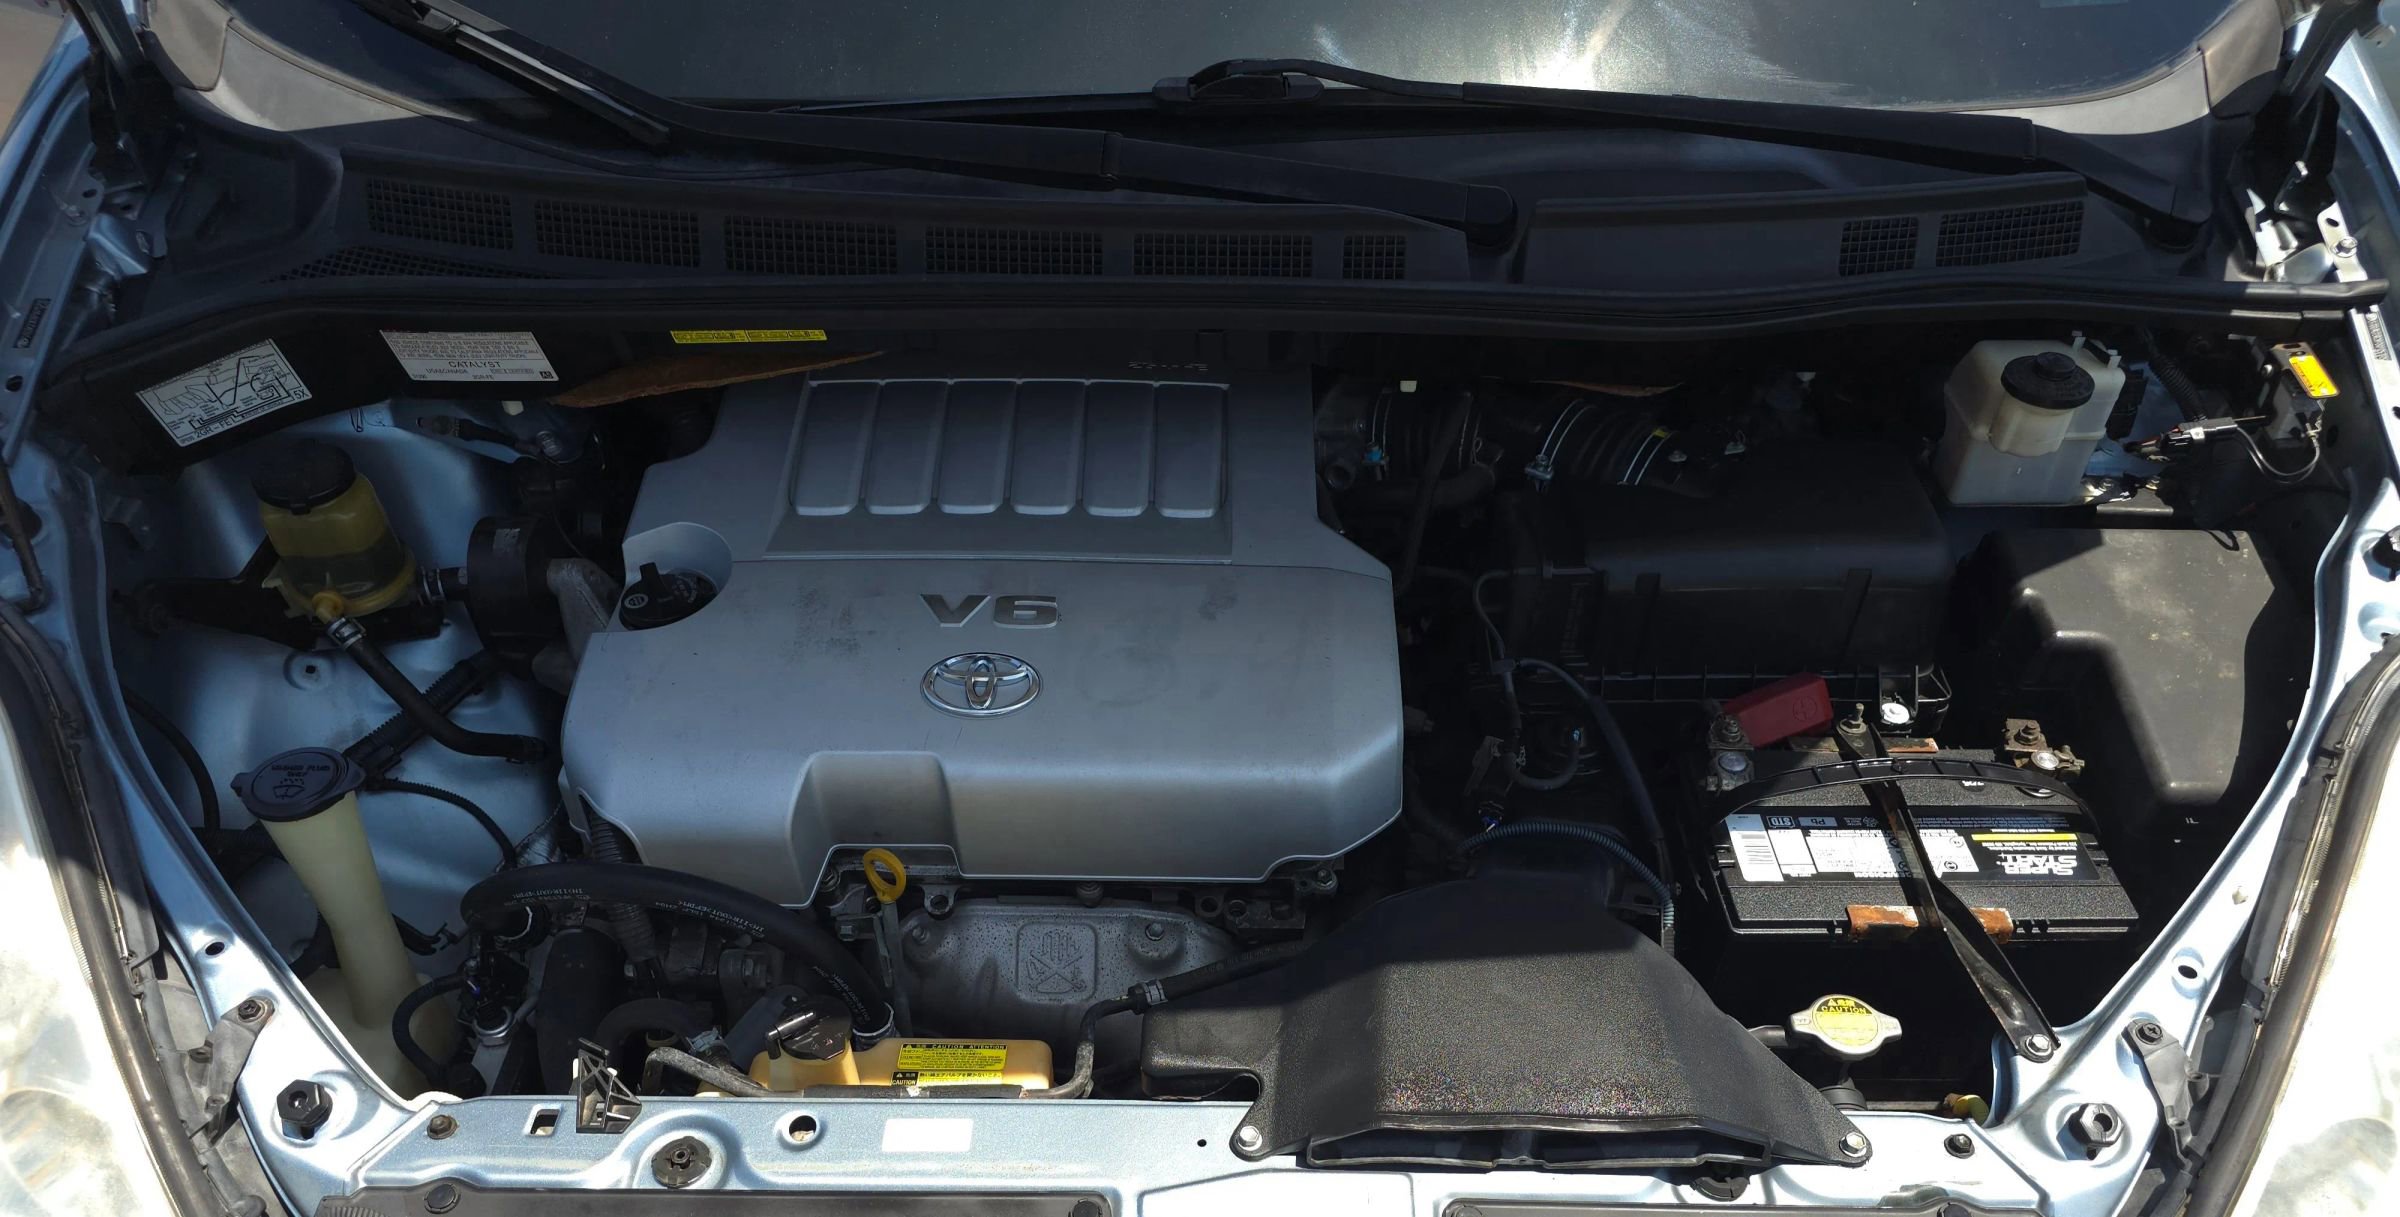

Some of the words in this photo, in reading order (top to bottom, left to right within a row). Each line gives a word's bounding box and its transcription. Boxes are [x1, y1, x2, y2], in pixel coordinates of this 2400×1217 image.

[293, 388, 310, 400] 5X
[920, 594, 1058, 629] V6
[1769, 817, 1792, 826] STD
[1811, 818, 1826, 827] Pb
[2004, 854, 2077, 868] START
[2004, 865, 2074, 876] SUPER
[1821, 1006, 1867, 1014] CAUTION
